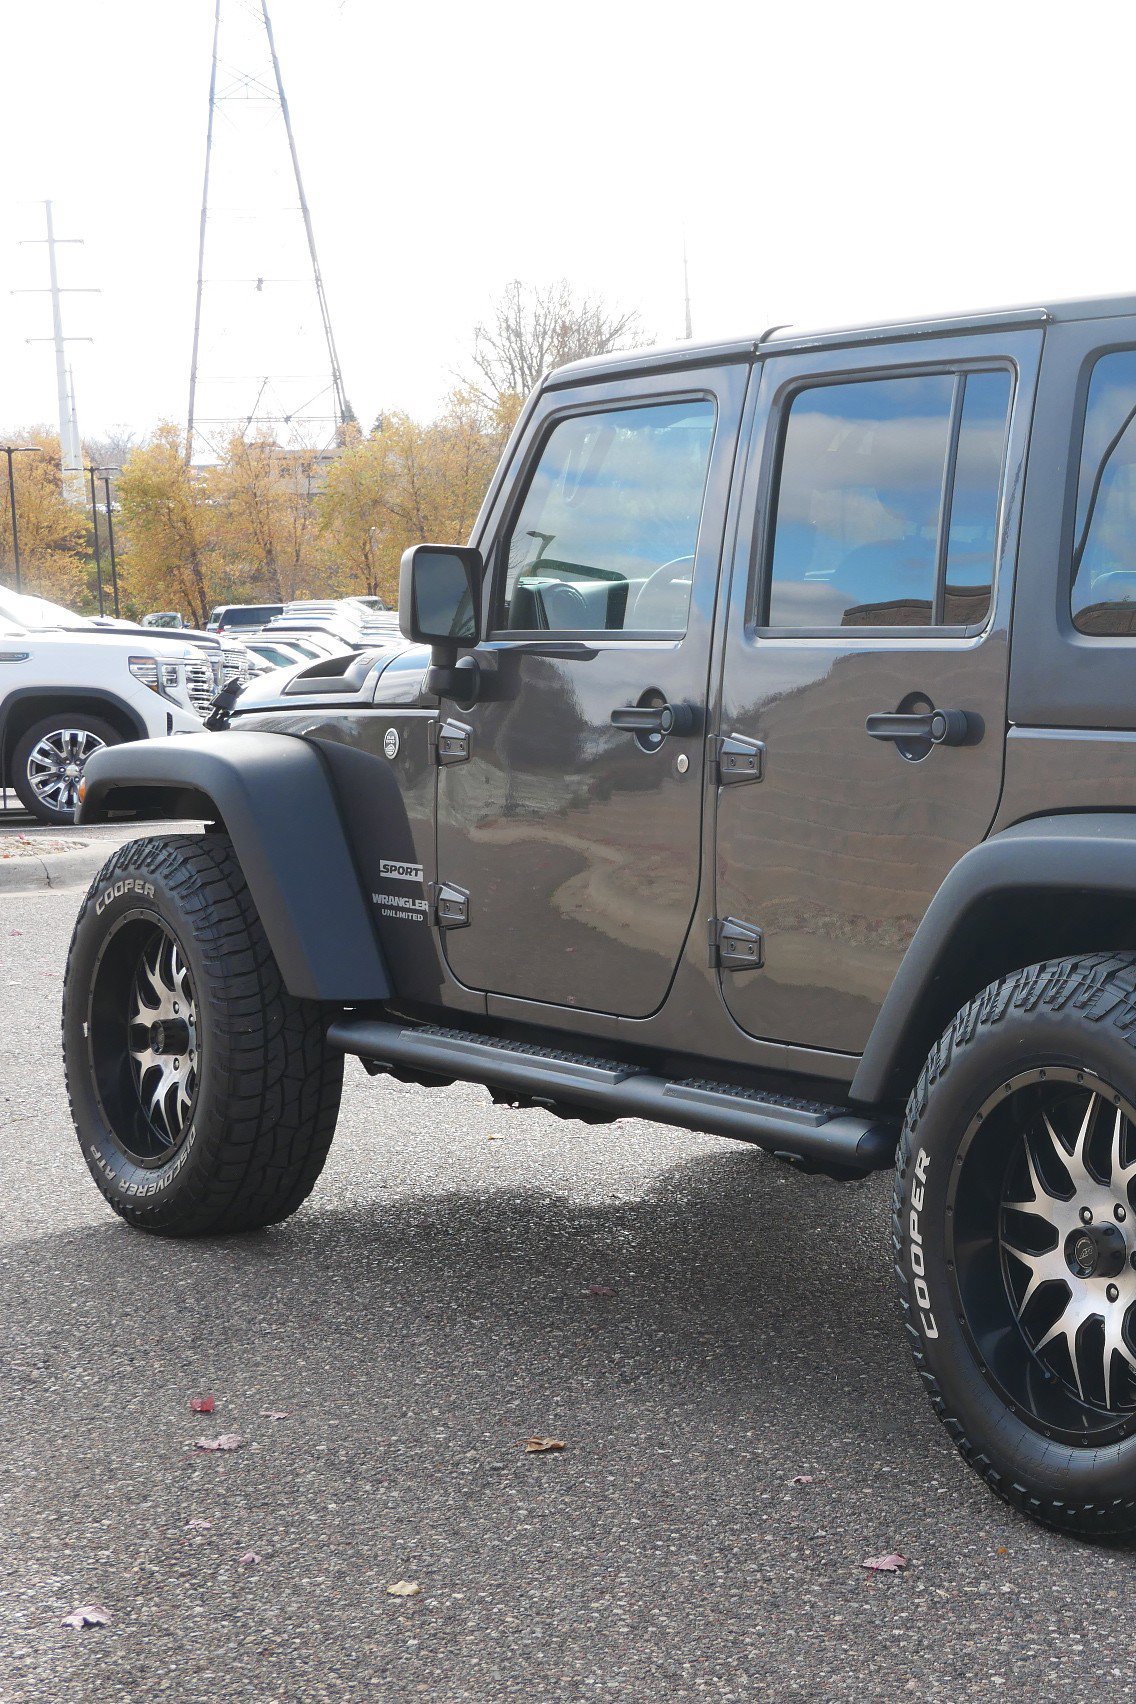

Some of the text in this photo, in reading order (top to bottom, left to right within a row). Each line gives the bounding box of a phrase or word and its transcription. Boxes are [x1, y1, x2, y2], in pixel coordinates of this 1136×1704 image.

[382, 863, 420, 877] SPORT
[95, 878, 156, 915] COOPER
[372, 893, 429, 912] WRANGLER
[382, 908, 424, 921] UNLIMITED
[118, 1124, 197, 1197] DISCOVERER
[908, 1147, 939, 1339] COOPER
